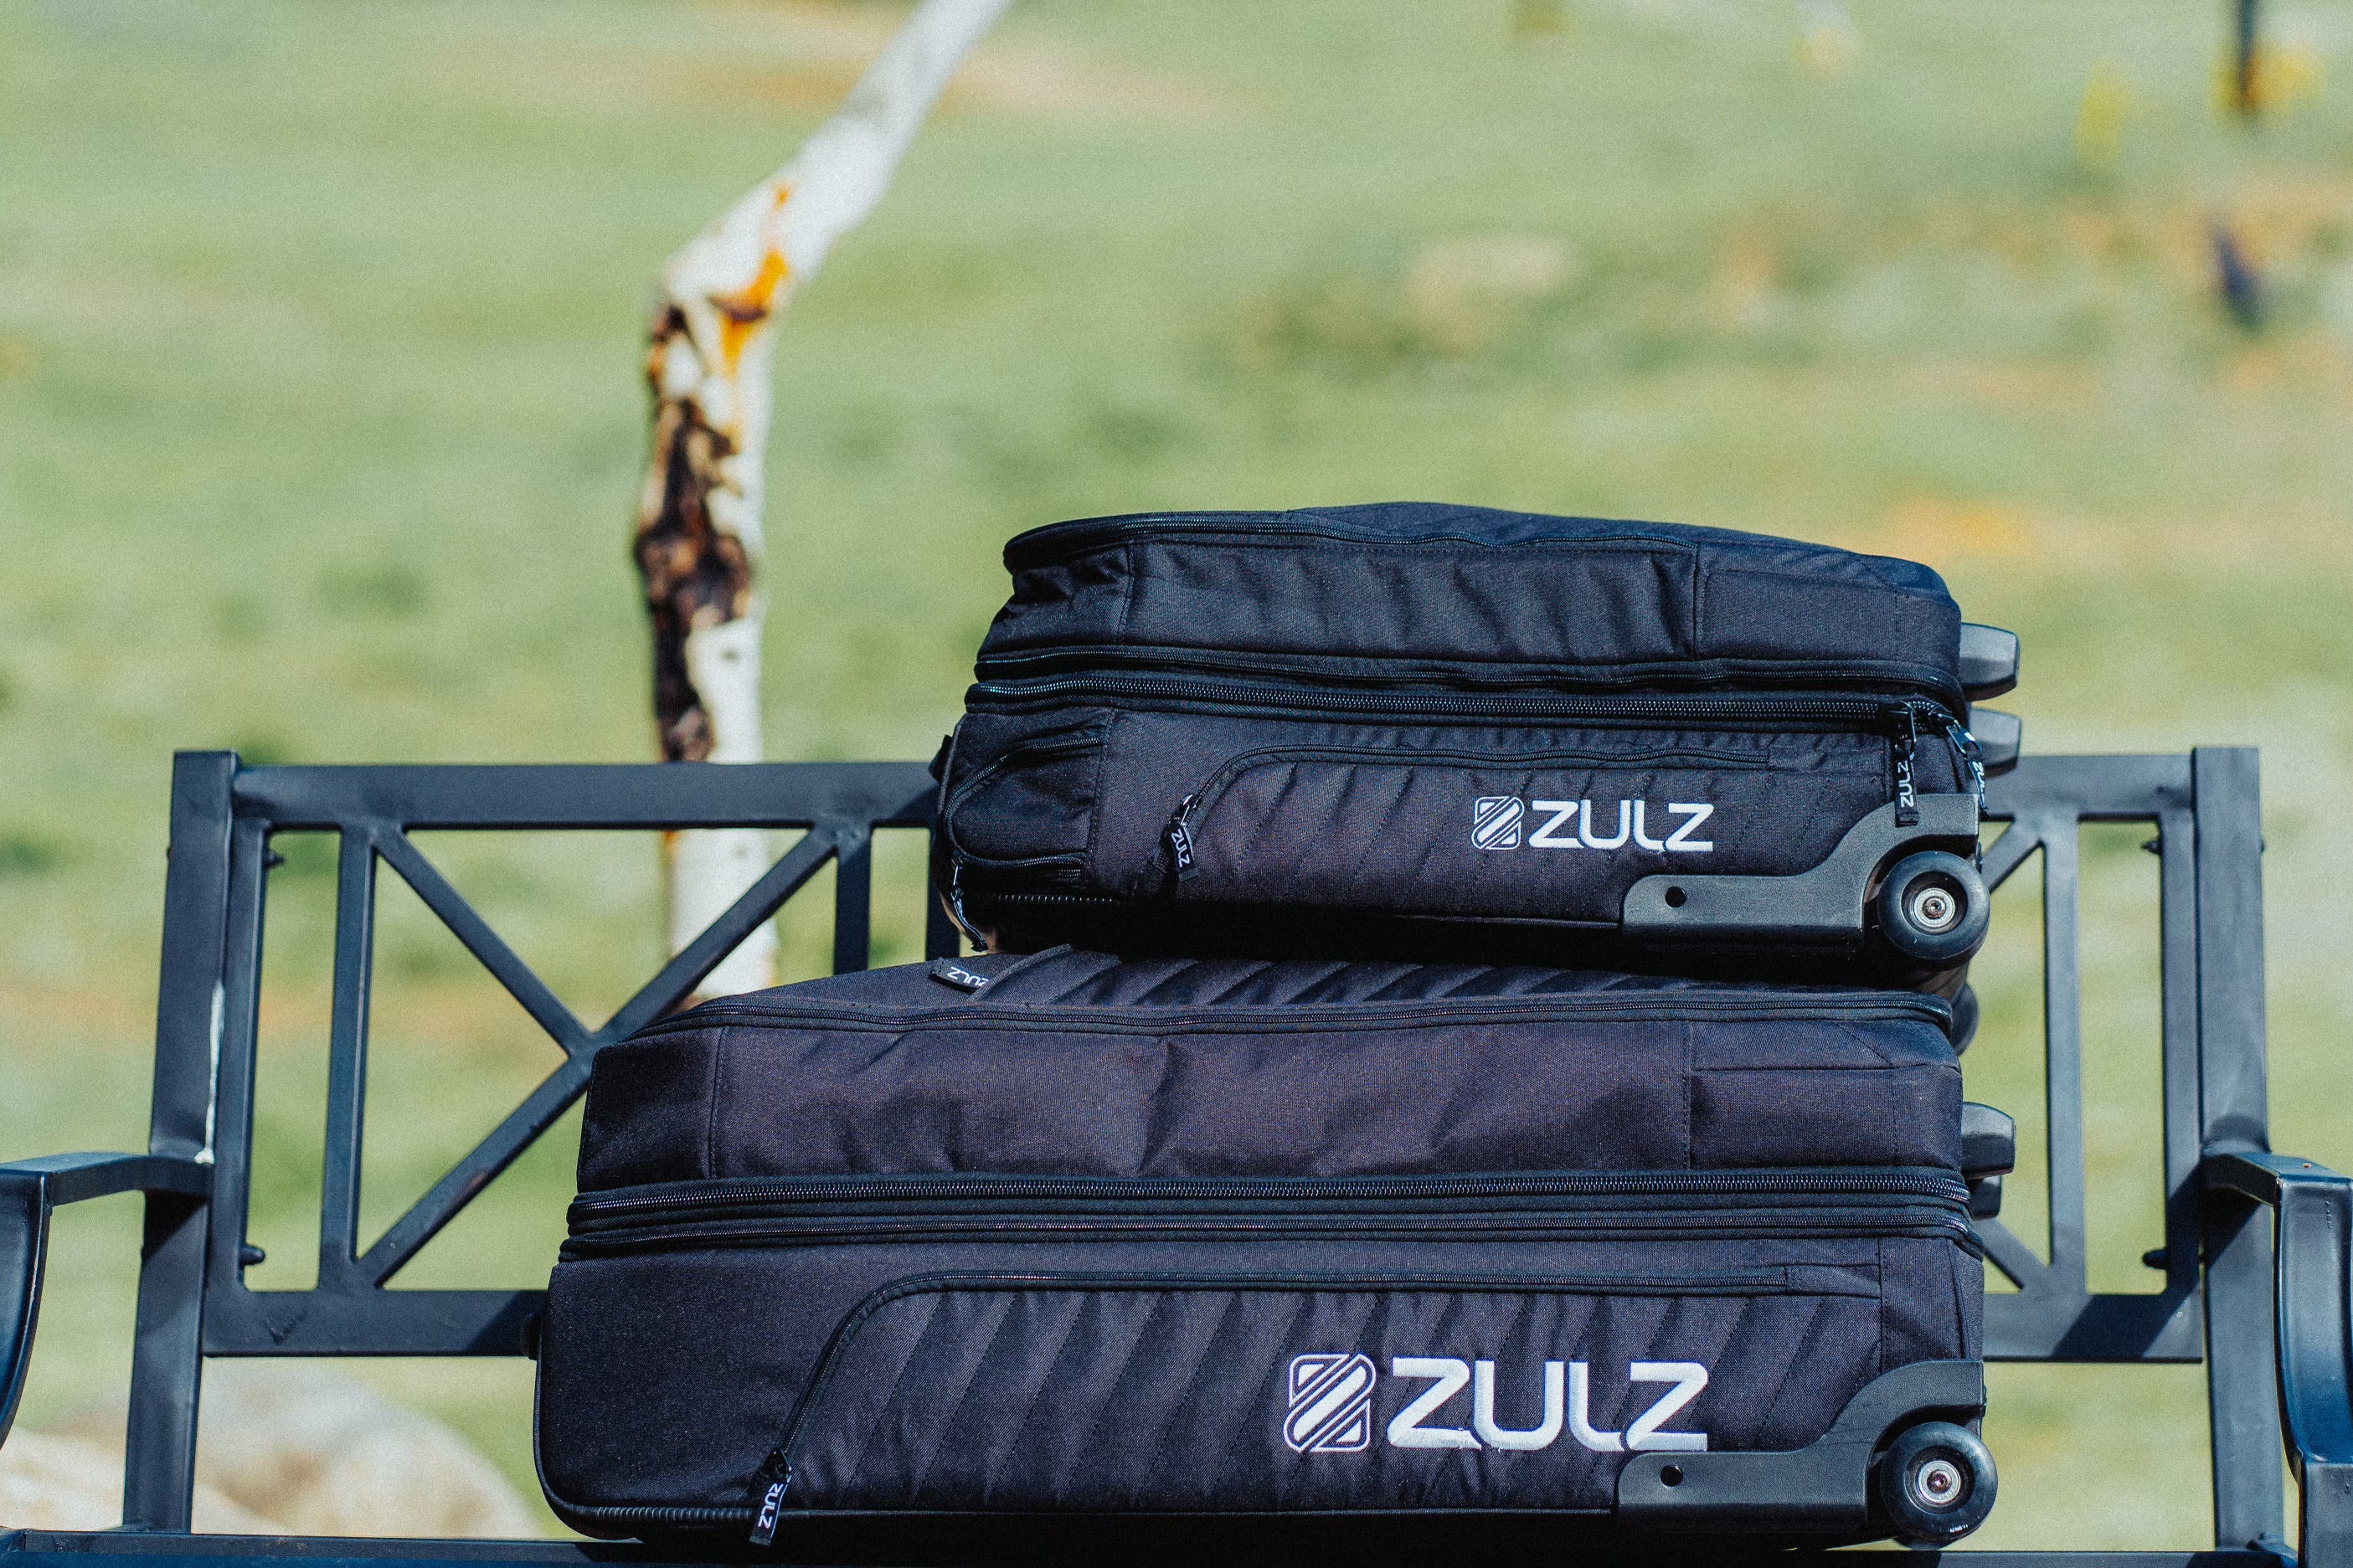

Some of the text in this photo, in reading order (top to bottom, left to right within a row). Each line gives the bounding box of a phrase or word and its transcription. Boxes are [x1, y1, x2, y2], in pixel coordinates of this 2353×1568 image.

[1897, 760, 1914, 808] ZULZ
[1171, 828, 1191, 868] ZULZ
[1528, 799, 1715, 852] ZULZ
[1387, 1356, 1708, 1452] ZULZ
[757, 1483, 785, 1529] ZULZ
